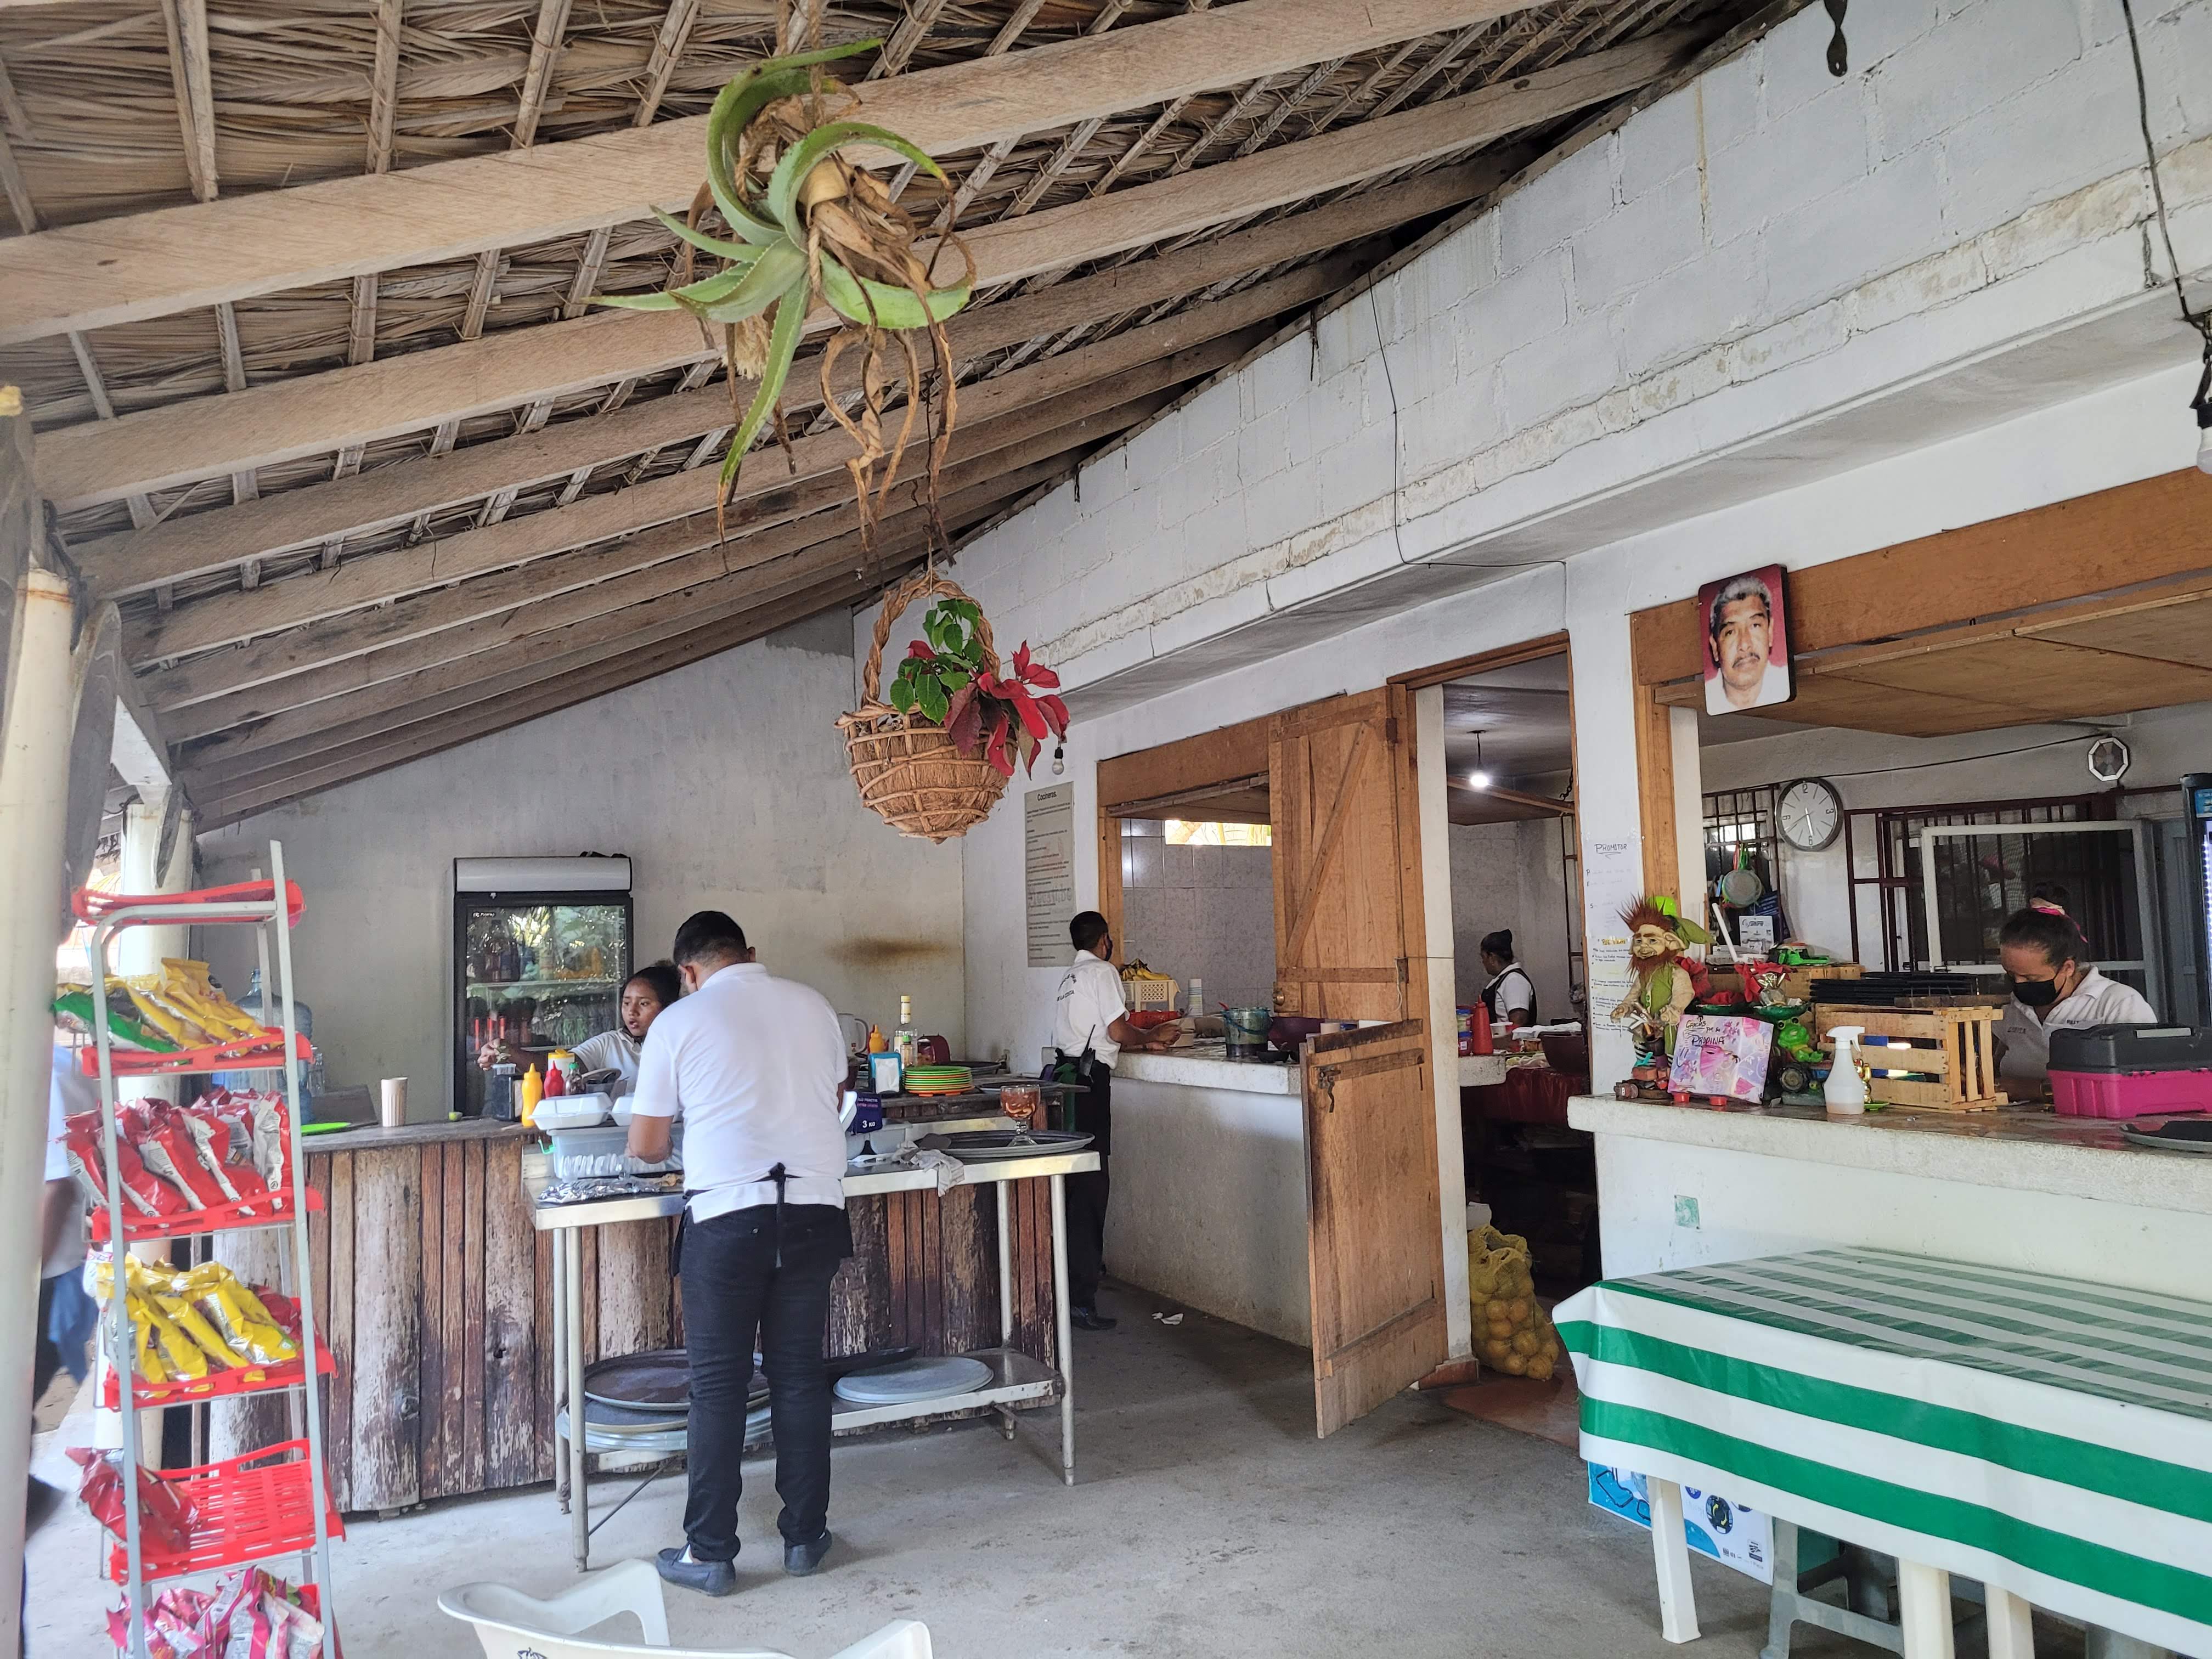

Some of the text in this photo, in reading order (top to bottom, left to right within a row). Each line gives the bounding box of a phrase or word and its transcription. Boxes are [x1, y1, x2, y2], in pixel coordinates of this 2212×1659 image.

[1808, 835, 1813, 845] 6
[1594, 843, 1627, 853] PROMOTOR
[862, 1120, 867, 1128] 3
